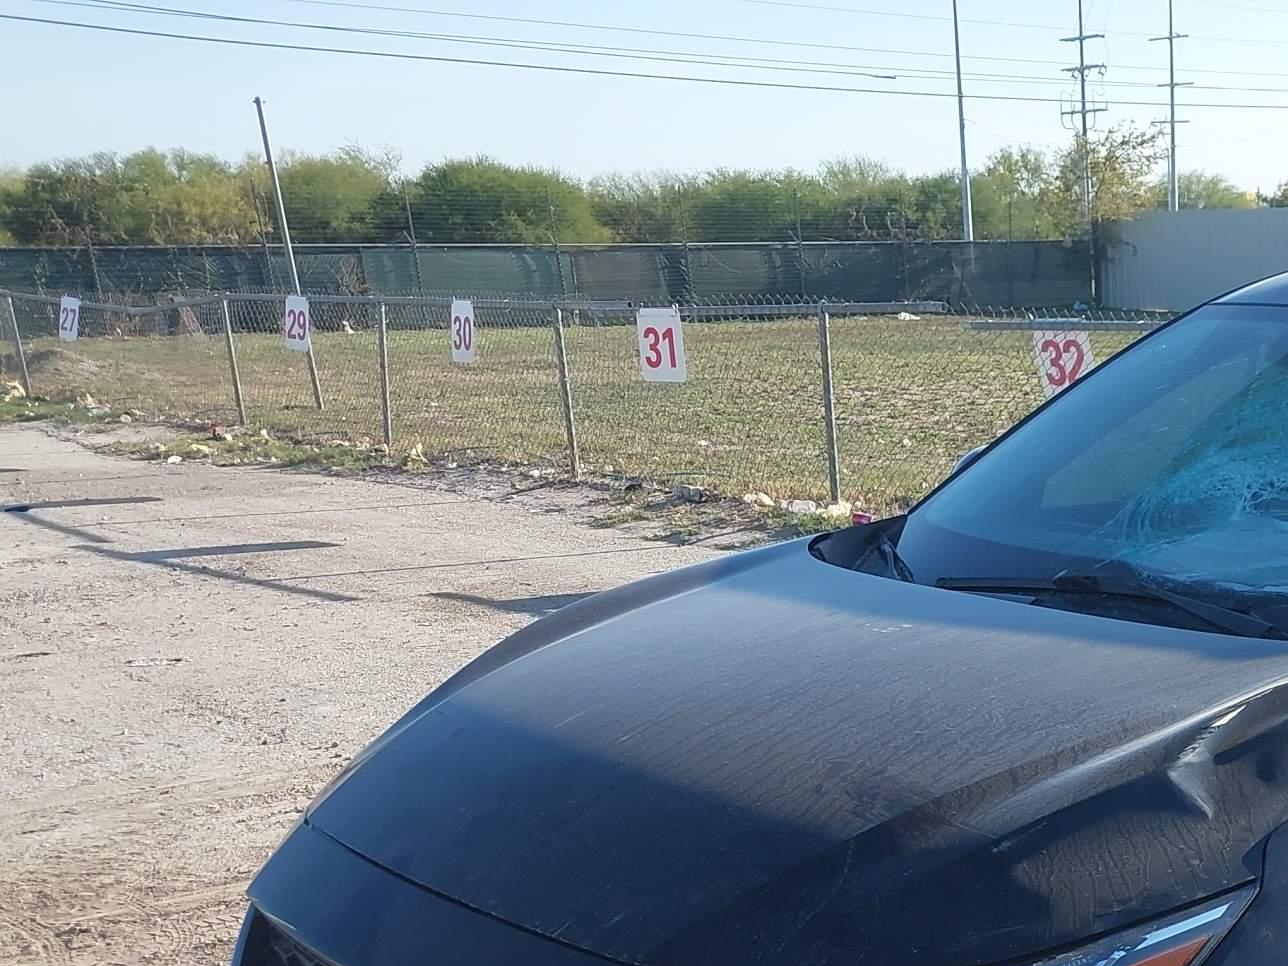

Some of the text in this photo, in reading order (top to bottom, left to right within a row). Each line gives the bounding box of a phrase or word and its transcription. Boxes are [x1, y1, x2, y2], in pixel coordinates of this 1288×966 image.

[60, 306, 77, 332] 27
[287, 308, 306, 341] 29
[453, 315, 472, 351] 30
[643, 327, 677, 368] 31
[1041, 340, 1085, 386] 32
